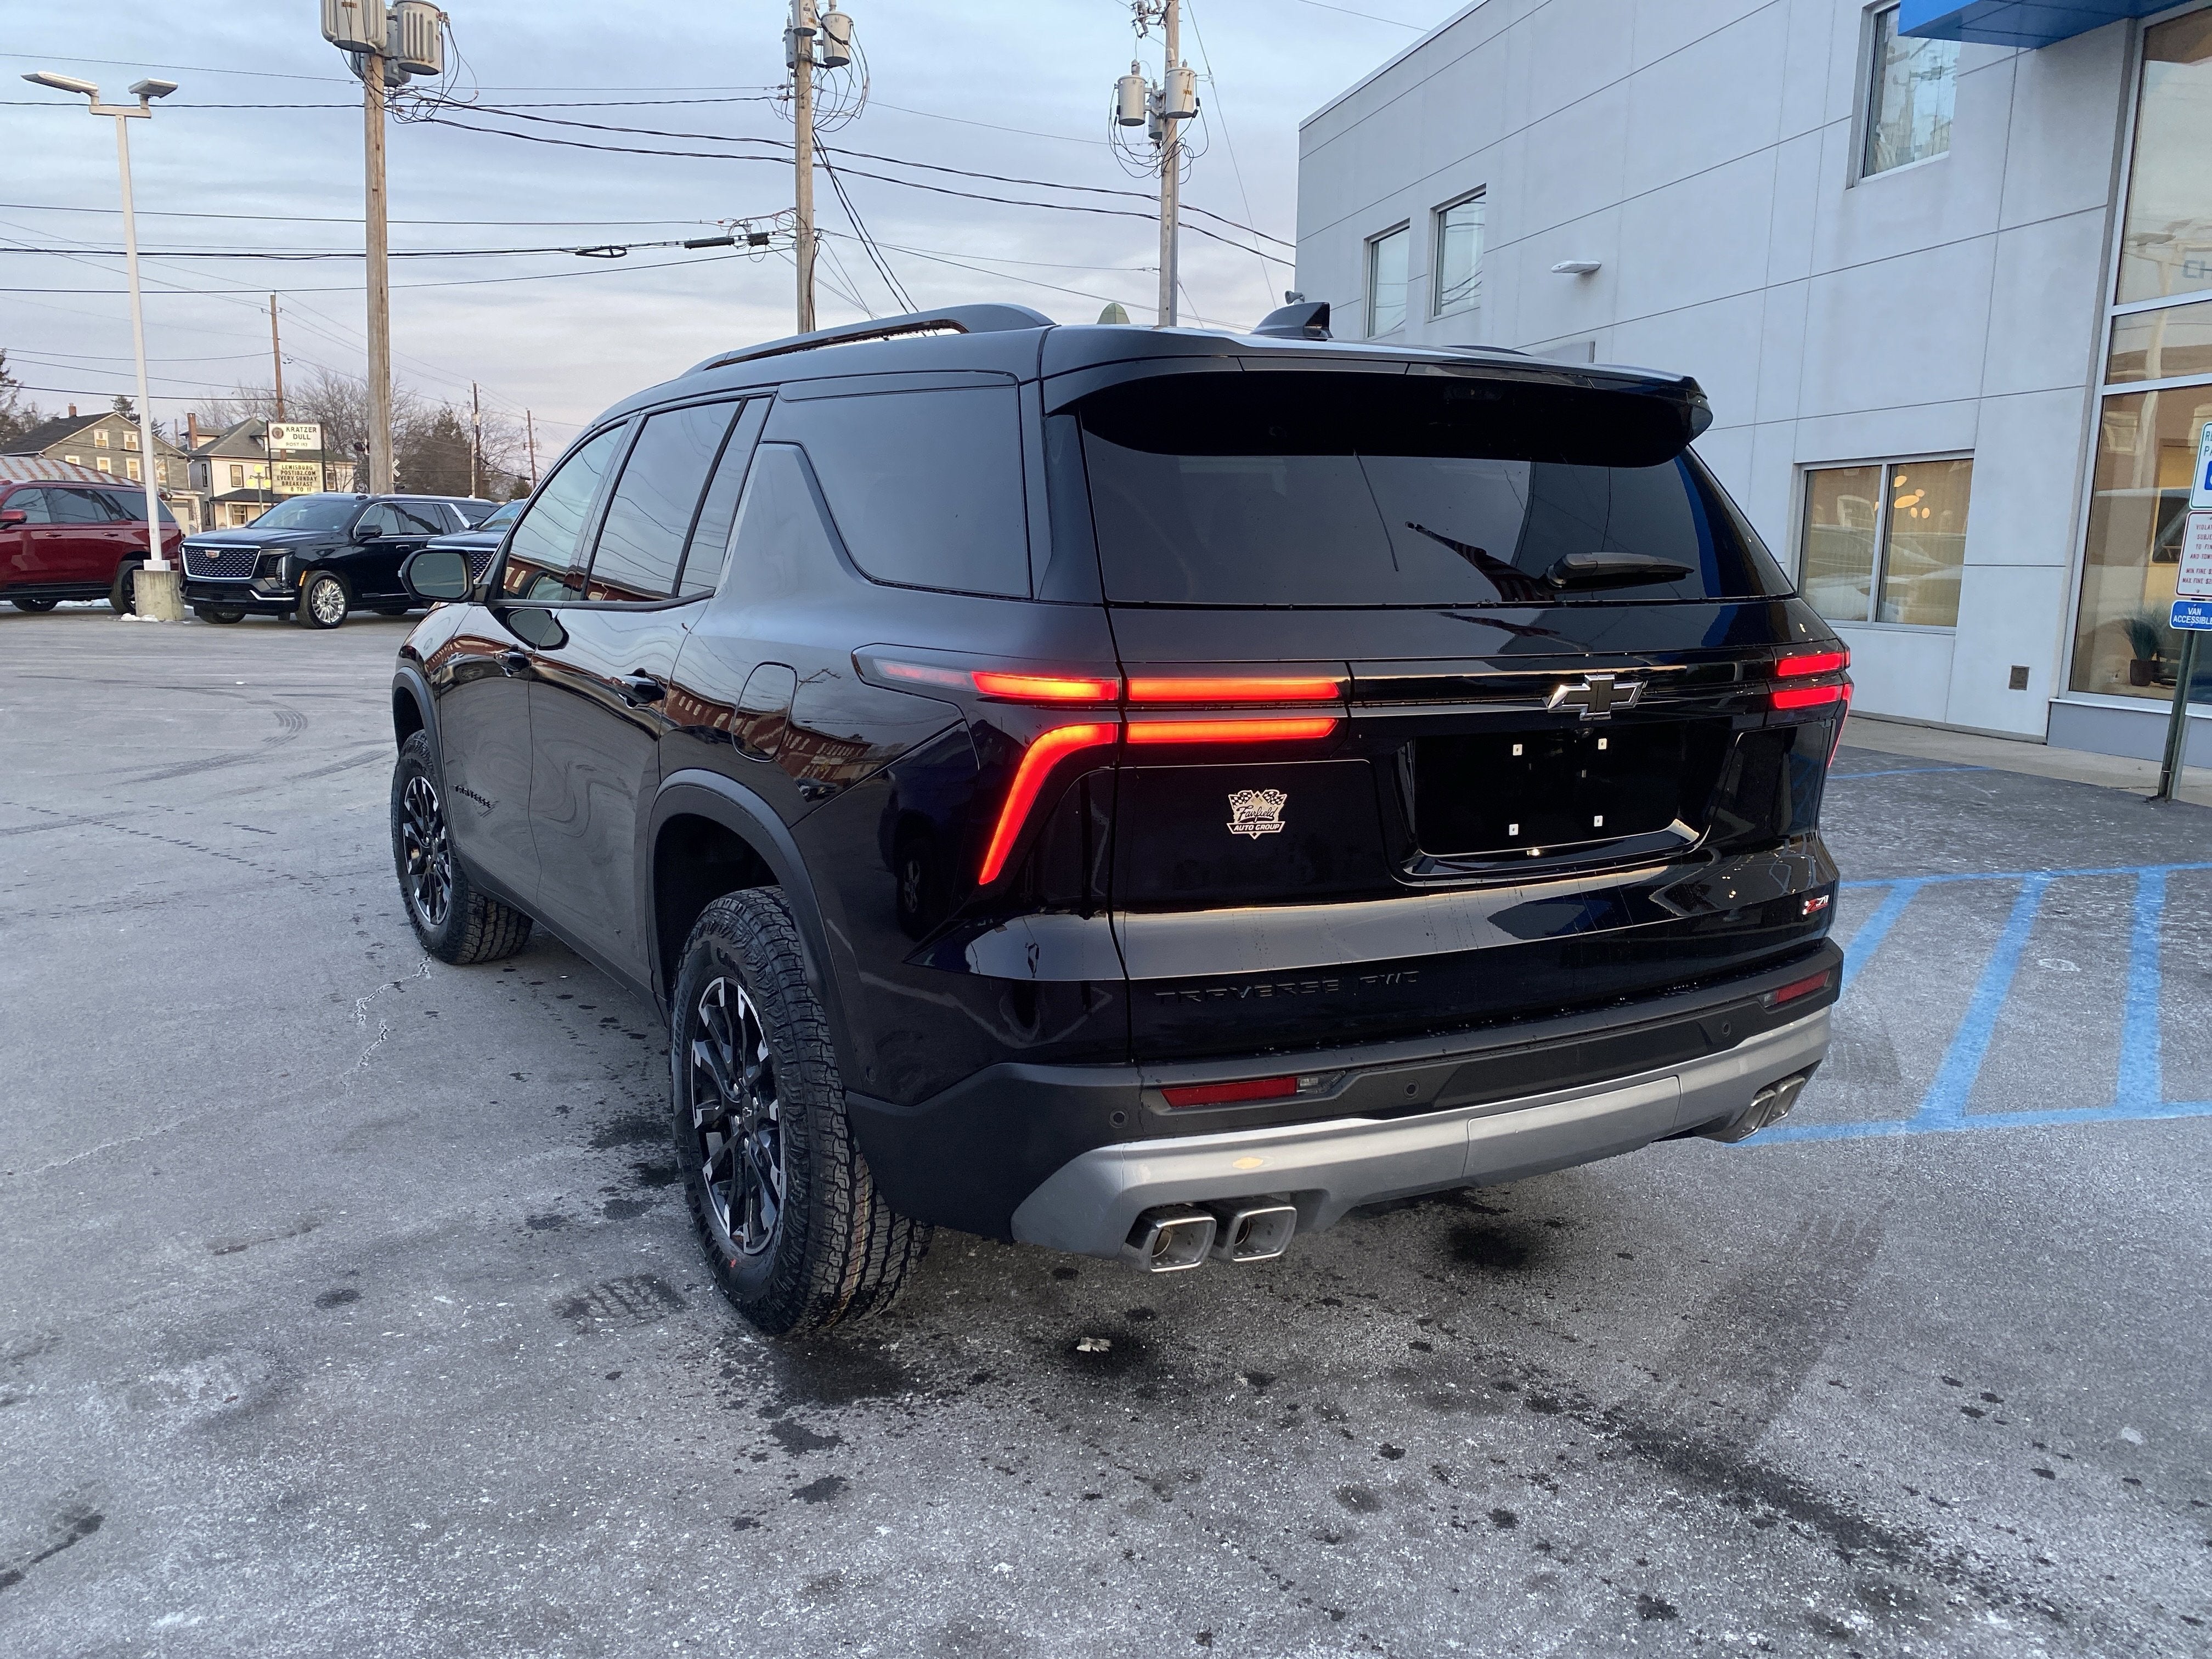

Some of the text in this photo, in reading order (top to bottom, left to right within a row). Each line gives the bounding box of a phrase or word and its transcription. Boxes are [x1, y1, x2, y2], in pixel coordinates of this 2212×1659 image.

[2172, 615, 2212, 625] ACCESSIBLE
[2188, 607, 2202, 616] VAN
[1235, 805, 1279, 823] Fairfield
[1802, 894, 1830, 916] Z71
[1154, 979, 1339, 1004] TRAVERSE
